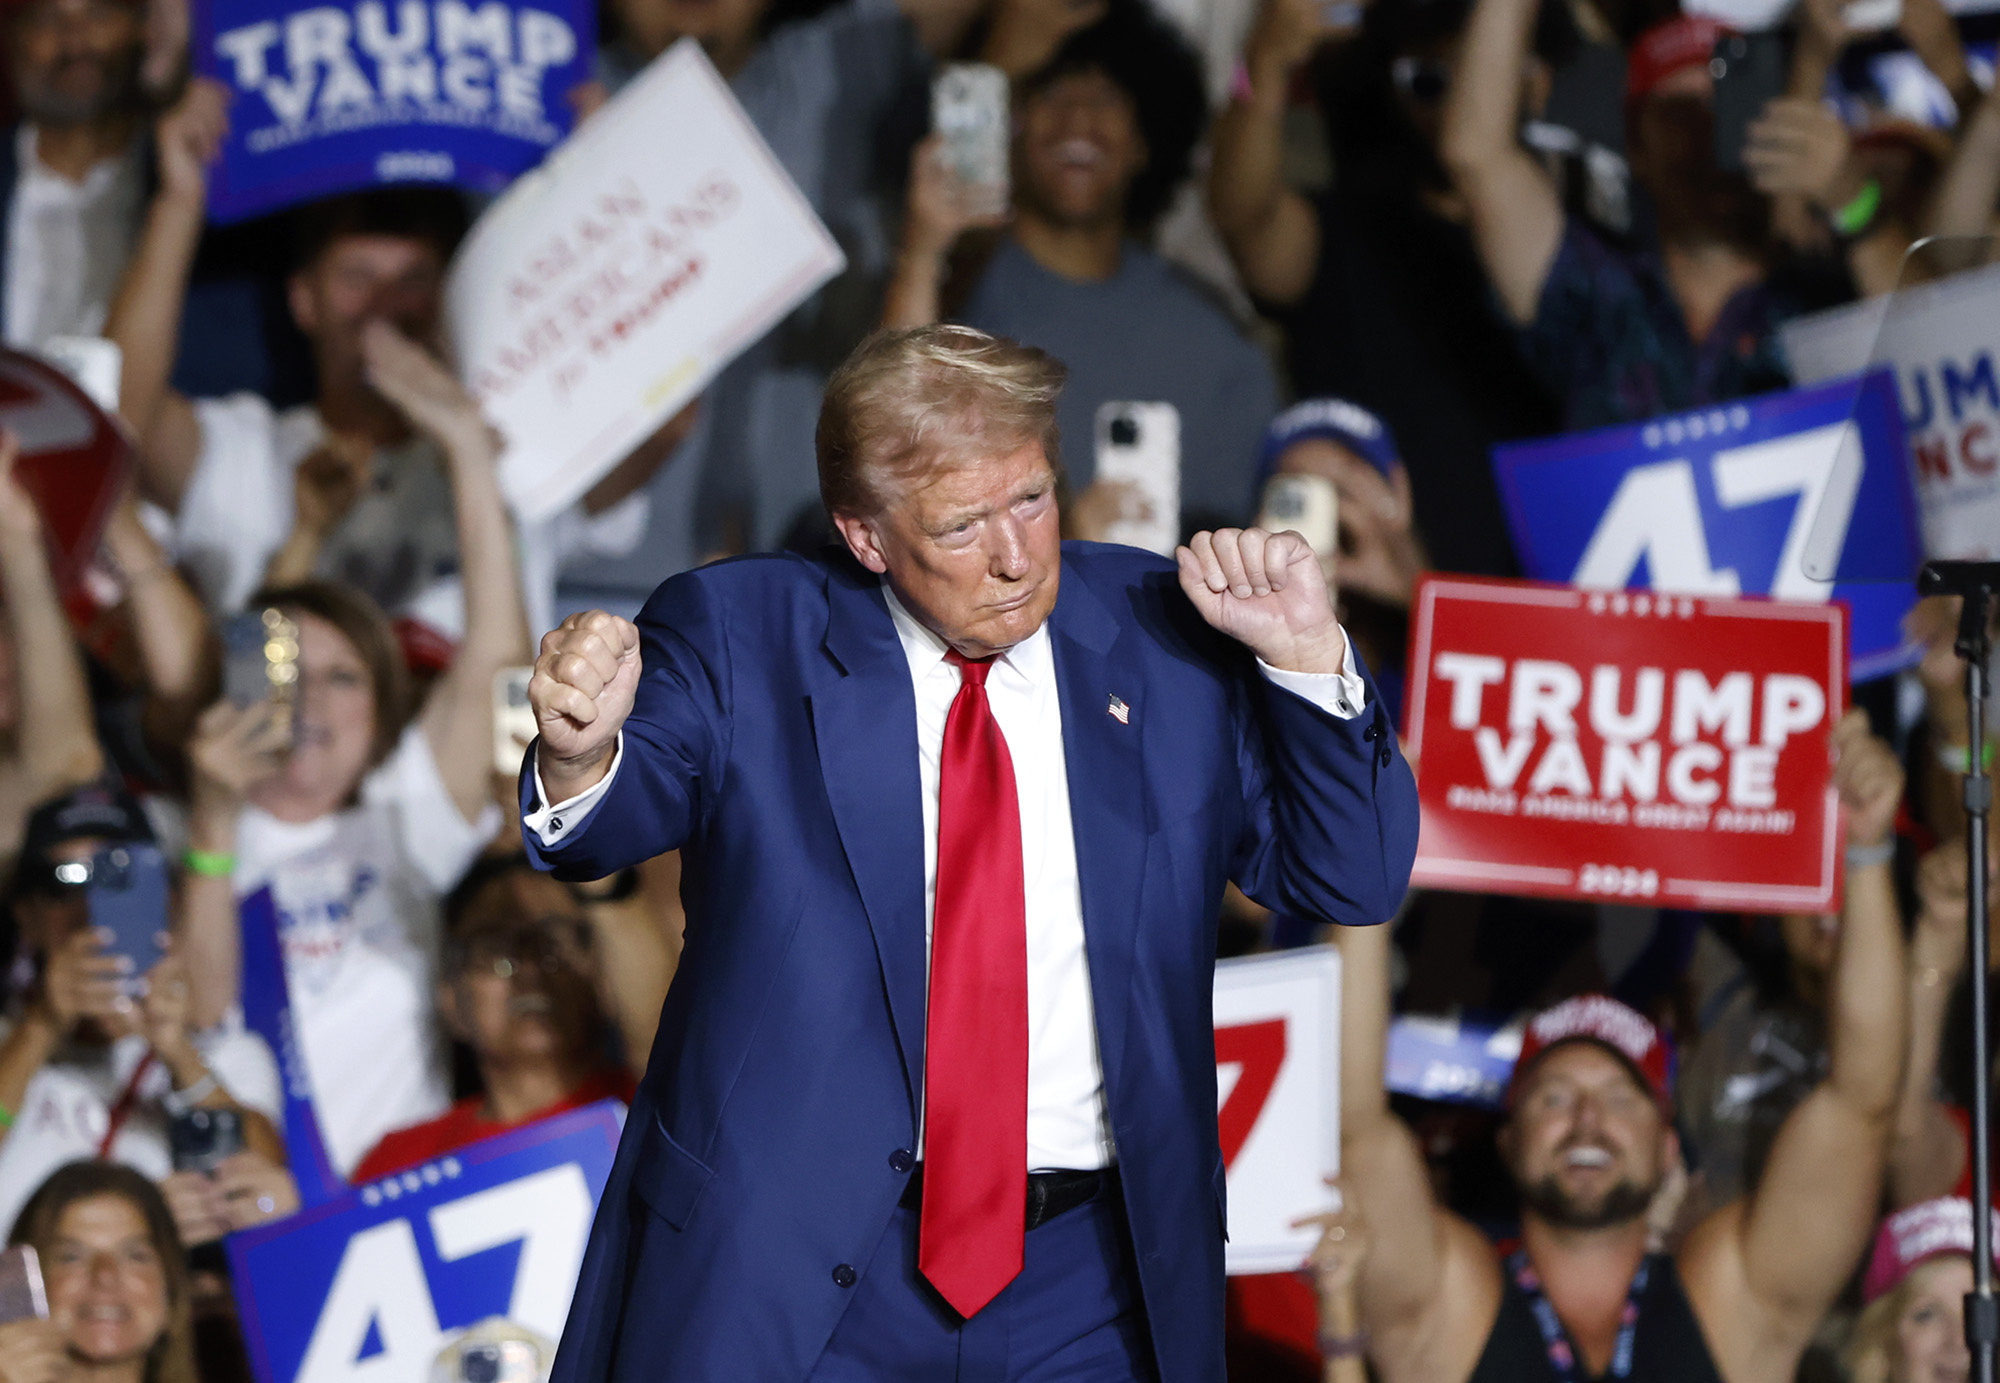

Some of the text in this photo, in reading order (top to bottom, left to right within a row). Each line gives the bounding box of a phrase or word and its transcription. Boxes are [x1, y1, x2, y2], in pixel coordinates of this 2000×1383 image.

[213, 0, 578, 92] TRUMP
[261, 52, 547, 131] VANCE
[1570, 418, 1865, 603] 47
[1435, 652, 1826, 749] TRUMP
[1475, 728, 1780, 809] VANCE
[290, 1162, 594, 1383] 47
